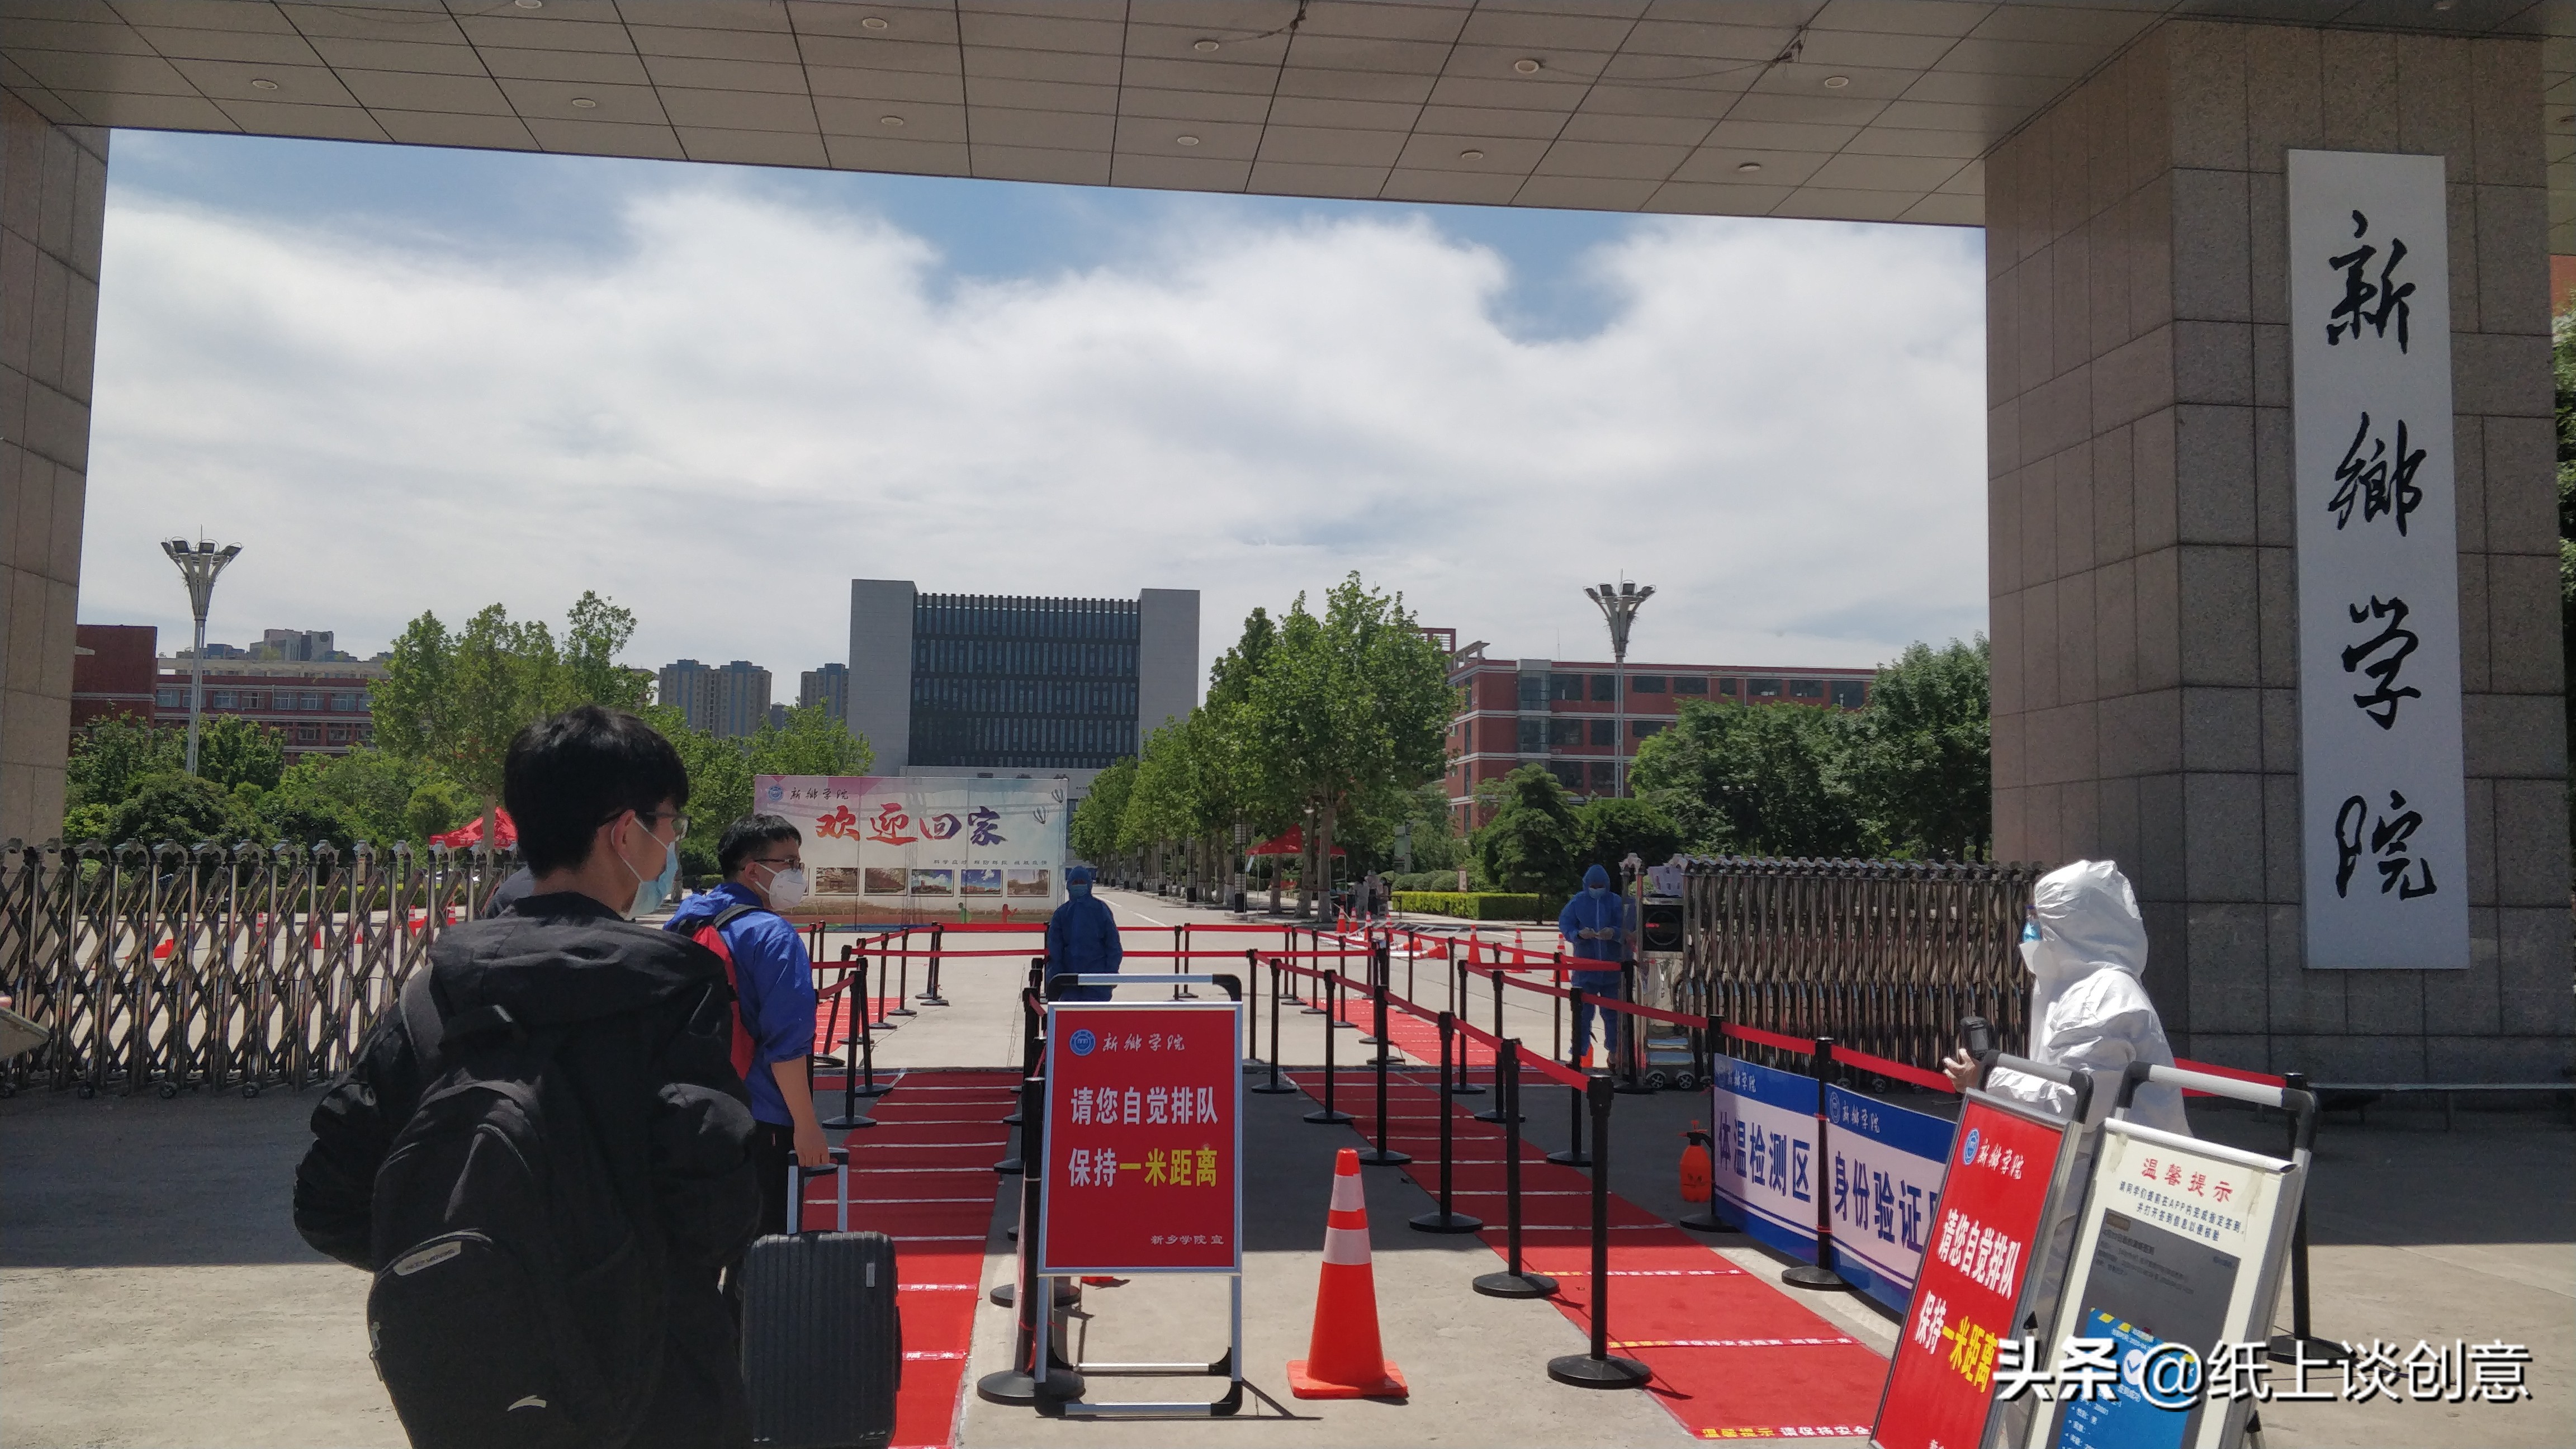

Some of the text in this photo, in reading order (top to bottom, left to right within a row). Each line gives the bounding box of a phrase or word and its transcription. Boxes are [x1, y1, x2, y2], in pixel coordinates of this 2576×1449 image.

[815, 802, 1008, 847] 欢迎回家
[1070, 1086, 1219, 1125] 请您自觉排队
[1068, 1147, 1218, 1188] 保持一米距离
[1718, 1110, 1811, 1203] 体温检测区
[2141, 1158, 2233, 1202] 温馨提示
[1150, 1234, 1208, 1246] 新乡学院
[1936, 1208, 2021, 1301] 请您自觉排队
[1913, 1289, 1999, 1394] 保持一米距离
[1779, 1425, 1873, 1437] 请保持安全
